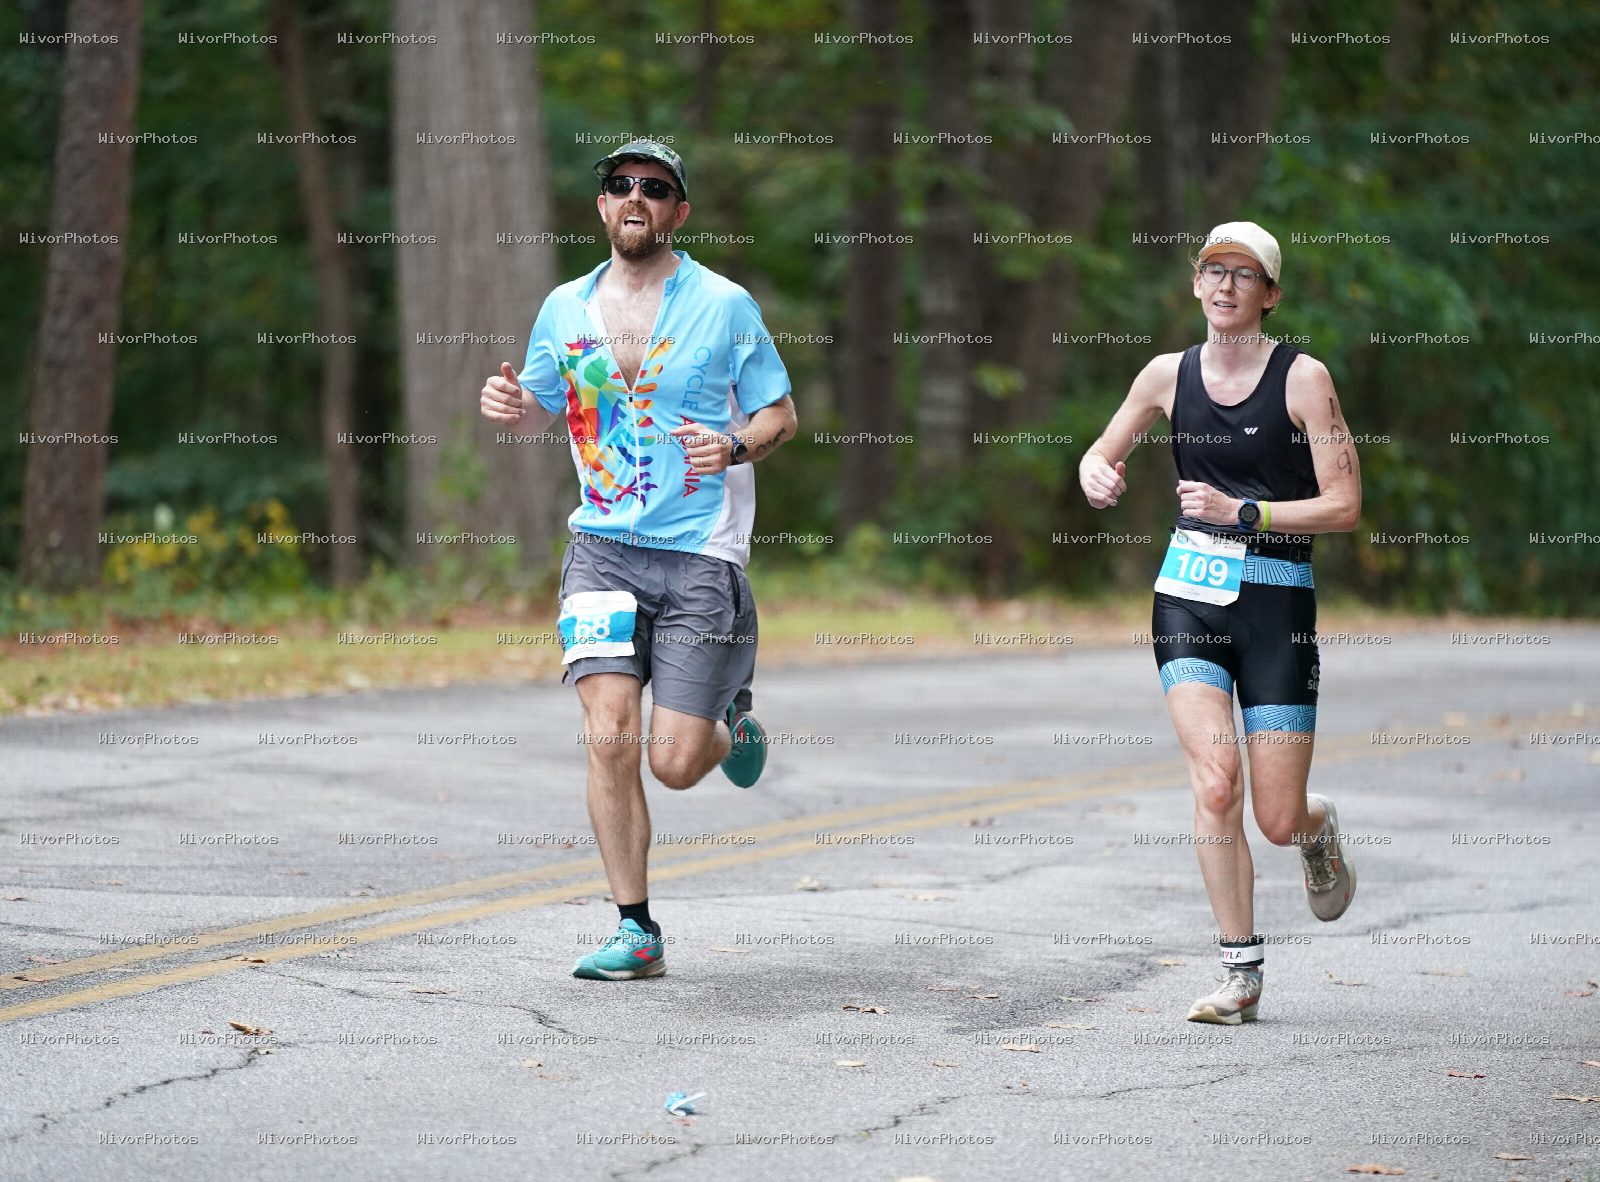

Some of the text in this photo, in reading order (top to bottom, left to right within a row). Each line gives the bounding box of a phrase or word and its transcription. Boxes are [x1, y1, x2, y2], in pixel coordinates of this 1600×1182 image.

[682, 346, 712, 412] CYCLE
[1177, 552, 1229, 587] 109
[574, 614, 611, 640] 68
